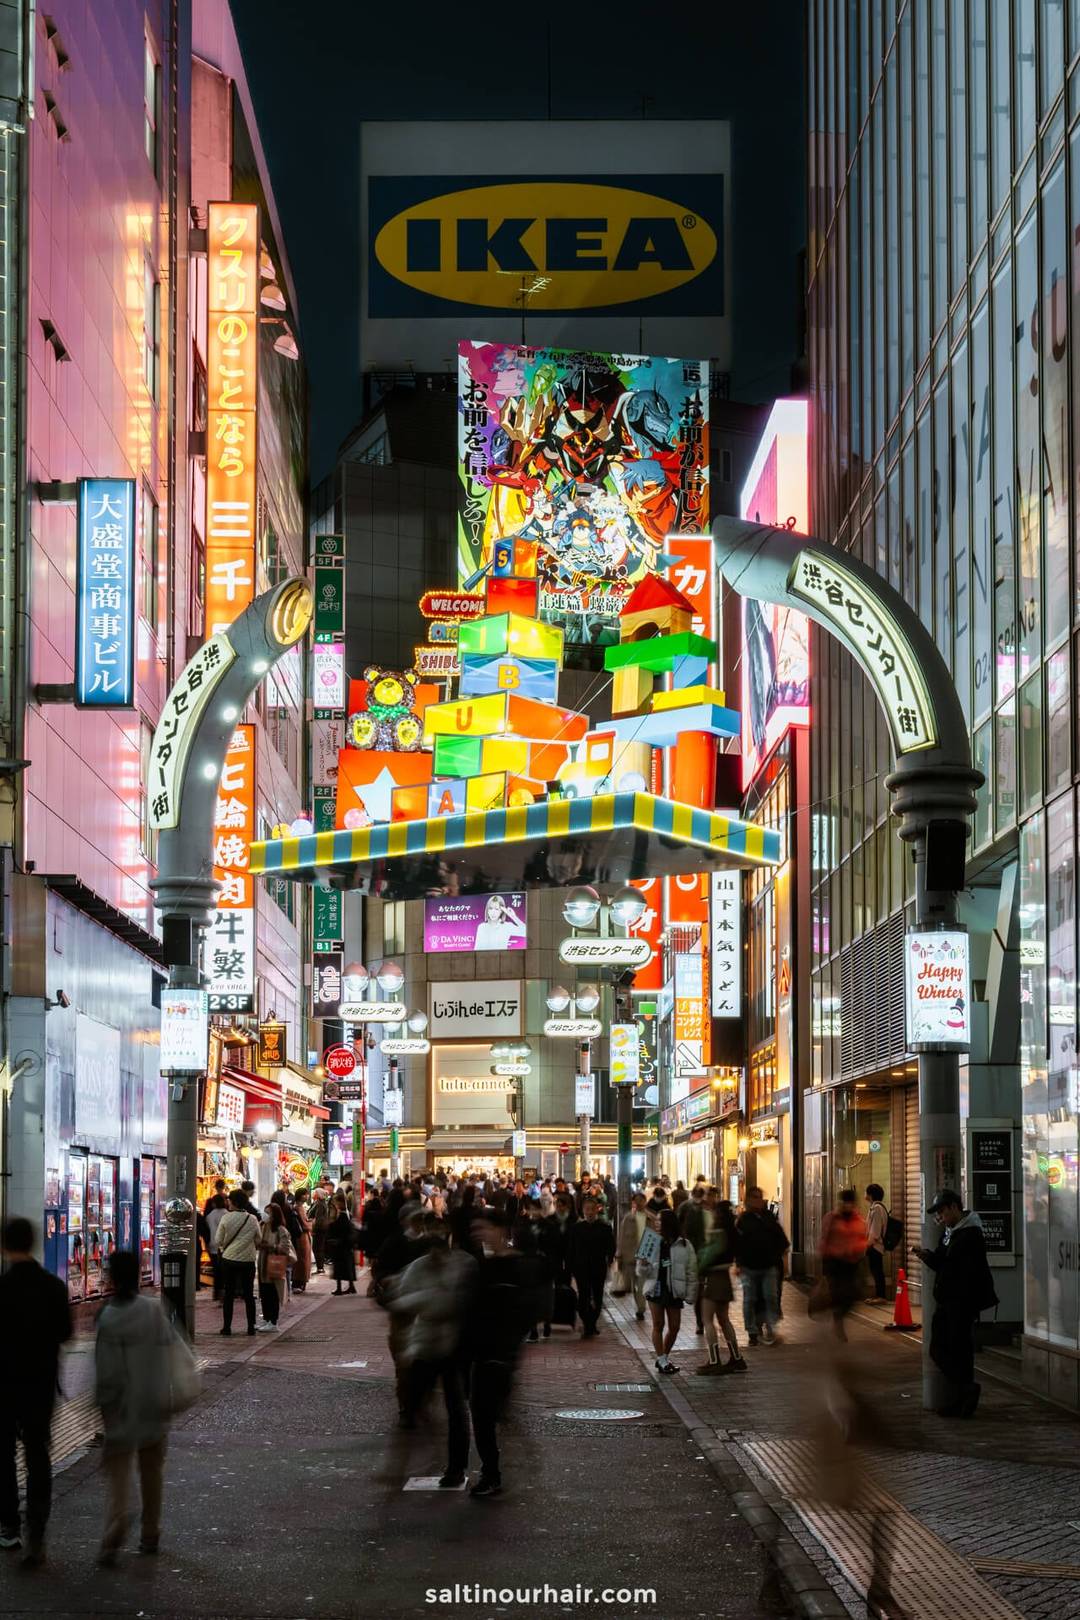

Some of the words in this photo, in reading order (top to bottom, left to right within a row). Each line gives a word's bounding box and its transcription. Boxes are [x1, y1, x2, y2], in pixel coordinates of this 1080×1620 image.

[406, 217, 695, 272] IKEA
[214, 215, 251, 479] クスリのことなら
[209, 501, 252, 634] 三千
[89, 493, 123, 694] 大盛堂商事ビル
[317, 634, 331, 642] 4F
[803, 561, 919, 737] 渋谷センター街
[498, 664, 521, 690] B
[456, 706, 473, 732] U
[152, 643, 221, 823] 渋谷センター街
[317, 787, 330, 796] 2F
[437, 789, 456, 815] A
[213, 911, 246, 981] 牛繁
[564, 945, 646, 957] 渋谷センター街
[716, 878, 735, 1011] 山下本気うどん
[917, 962, 964, 983] Happy
[916, 984, 964, 1000] Winter
[330, 1056, 354, 1069] 消火栓
